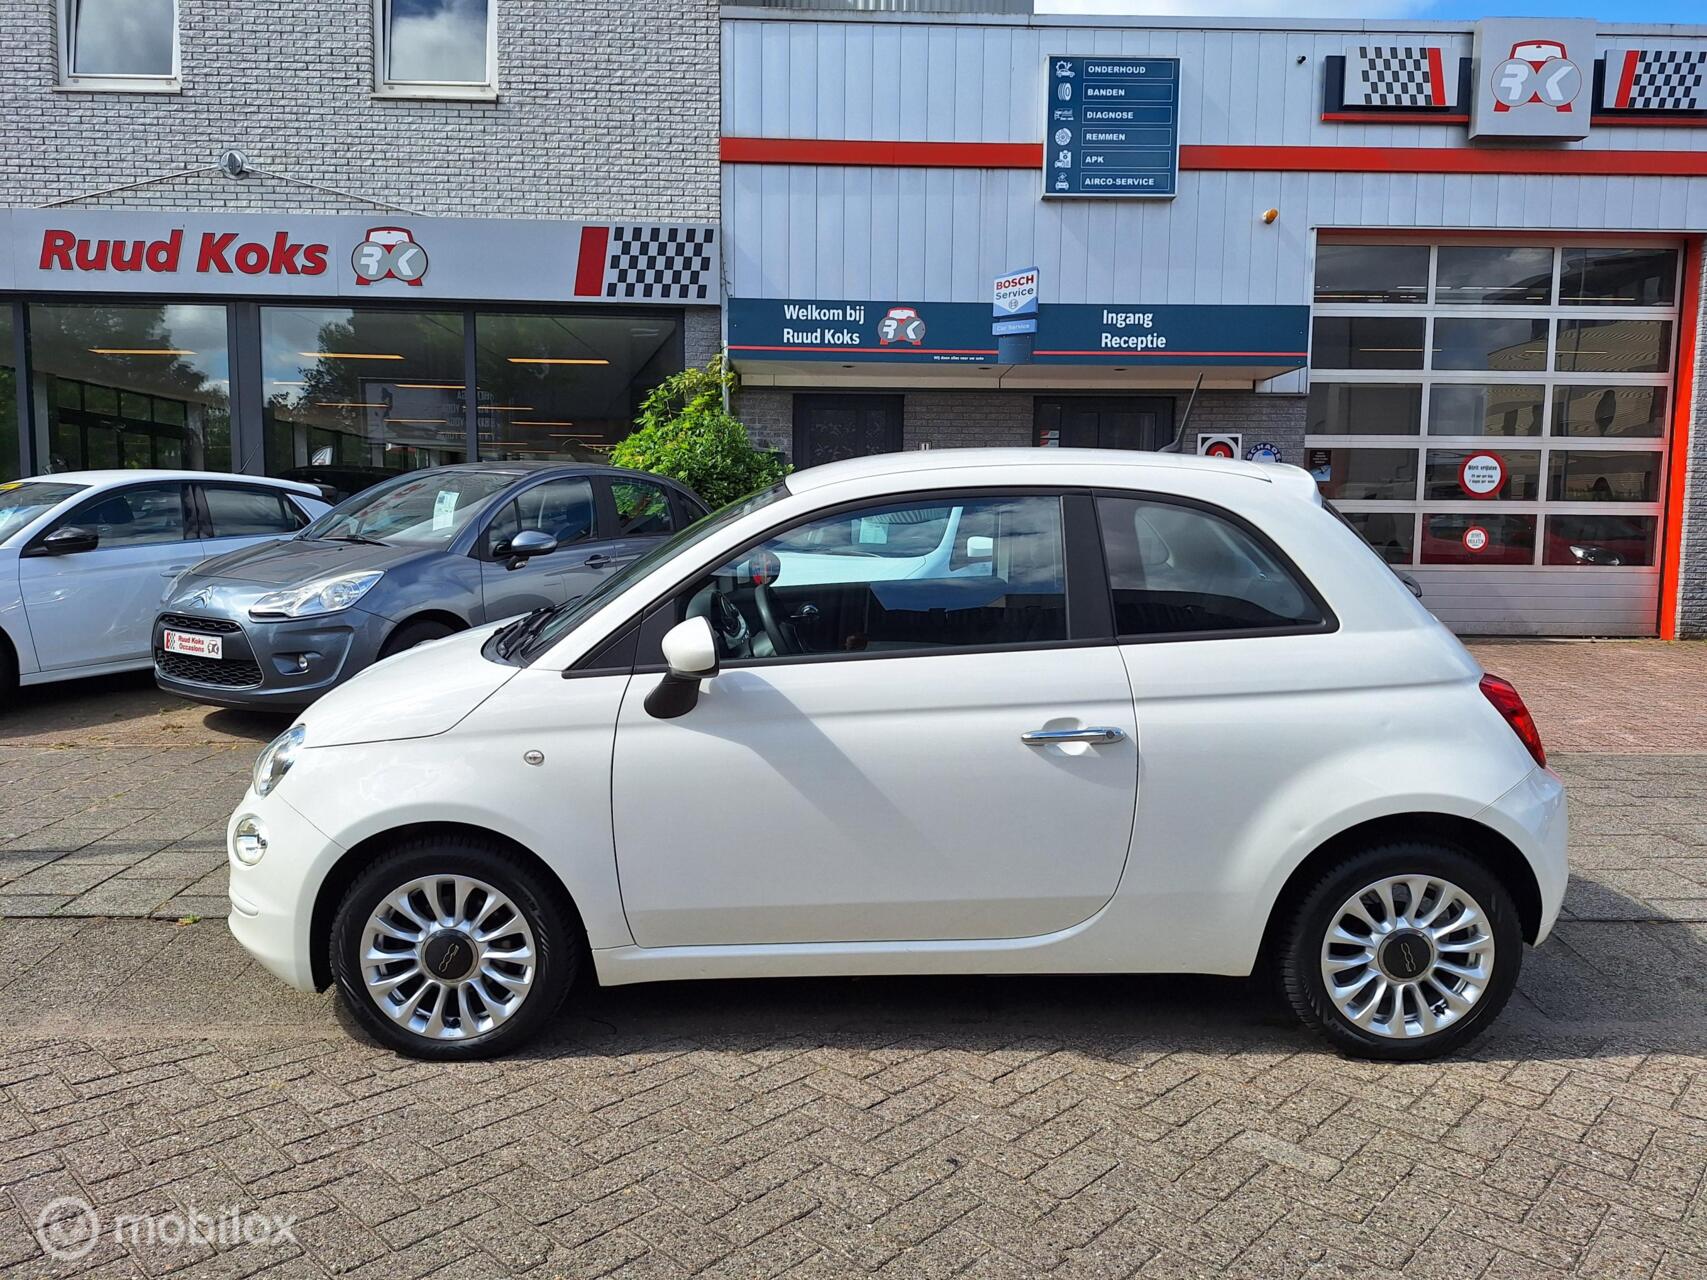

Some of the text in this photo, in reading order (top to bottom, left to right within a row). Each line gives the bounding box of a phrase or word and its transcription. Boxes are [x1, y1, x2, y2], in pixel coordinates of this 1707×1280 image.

[1088, 66, 1146, 74] ONDERHOUD
[1087, 88, 1125, 96] BANDEN
[1086, 111, 1134, 119] DIAGNOSE
[1086, 133, 1126, 141] REMMEN
[1084, 178, 1155, 186] AIRCO-SERVICE
[39, 229, 330, 276] Ruud Koks
[996, 274, 1035, 291] BOSCH
[995, 287, 1034, 300] Service
[784, 304, 865, 325] Welkom bij
[1103, 309, 1153, 328] Ingang
[783, 328, 860, 345] Ruud Koks
[1101, 332, 1166, 351] Receptie
[178, 635, 204, 645] Ruud Koks
[179, 643, 205, 653] Occasions
